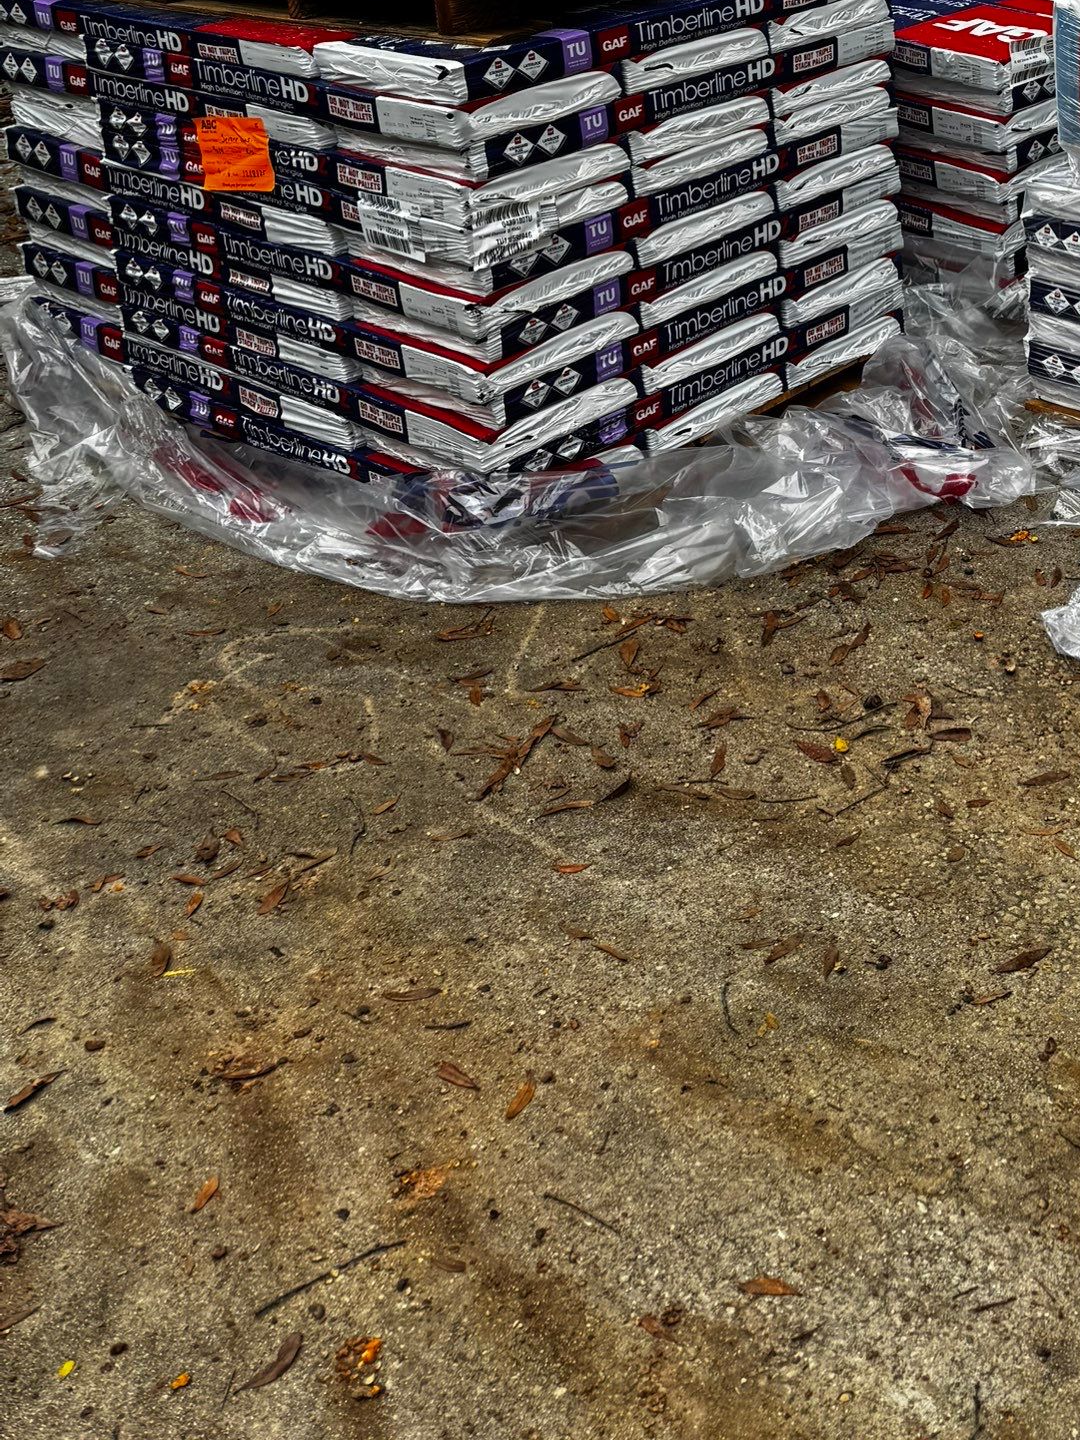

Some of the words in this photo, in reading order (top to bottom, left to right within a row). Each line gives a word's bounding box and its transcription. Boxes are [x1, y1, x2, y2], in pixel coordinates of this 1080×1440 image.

[37, 12, 51, 26] TU
[60, 20, 77, 32] GAF
[932, 18, 1048, 43] GAF
[567, 40, 586, 58] TU
[603, 35, 627, 52] GAF
[48, 64, 60, 79] TU
[171, 64, 190, 76] GAF
[69, 76, 86, 87] GAF
[618, 105, 643, 122] GAF
[201, 120, 217, 130] ABC
[584, 113, 603, 130] TU
[61, 152, 74, 165] TU
[84, 163, 101, 178] GAF
[72, 215, 84, 230] TU
[623, 209, 648, 228] GAF
[94, 228, 112, 241] GAF
[589, 221, 607, 236] TU
[197, 233, 216, 246] GAF
[78, 270, 91, 284] TU
[100, 284, 117, 297] GAF
[631, 277, 655, 295] GAF
[201, 292, 220, 305] GAF
[598, 288, 616, 305] TU
[82, 323, 96, 336] TU
[104, 336, 121, 350] GAF
[633, 339, 657, 357] GAF
[600, 350, 617, 366] TU
[636, 402, 660, 421] GAF
